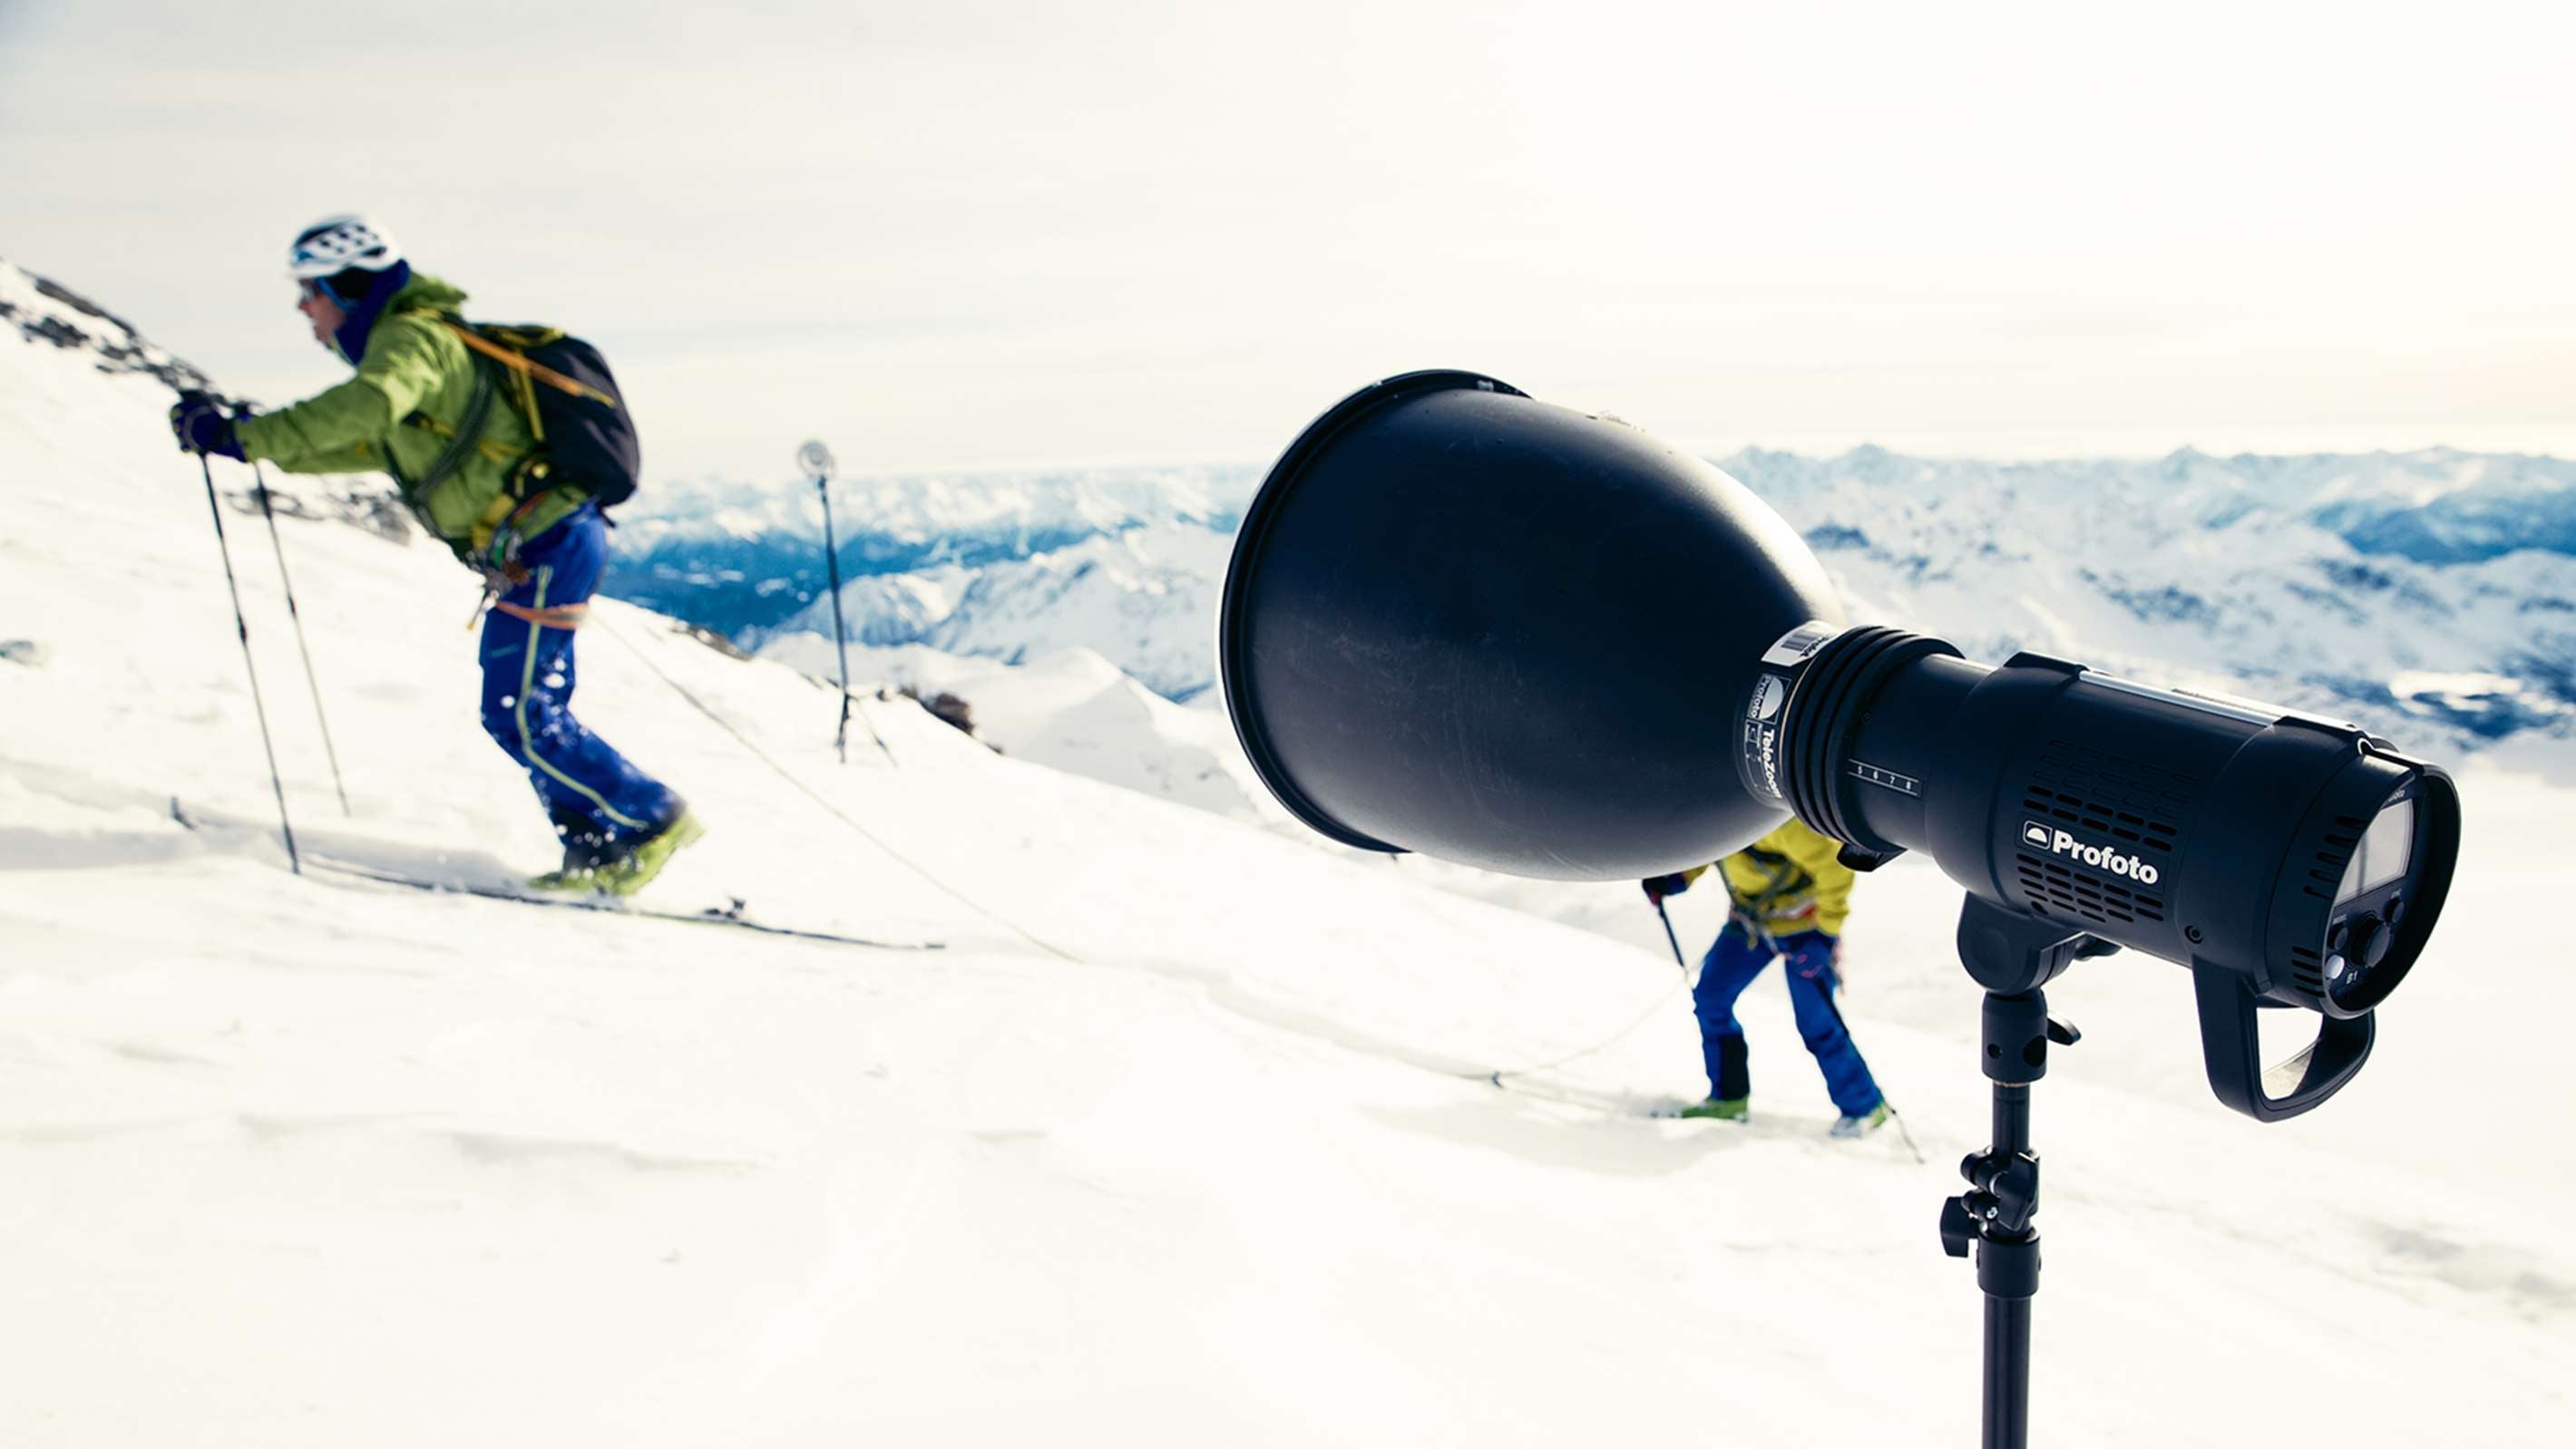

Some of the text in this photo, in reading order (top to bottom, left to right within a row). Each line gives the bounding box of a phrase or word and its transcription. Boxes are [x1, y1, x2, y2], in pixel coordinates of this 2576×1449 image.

[1857, 765, 1863, 775] 5
[1873, 771, 1879, 780] 6
[1889, 775, 1896, 784] 7
[2052, 830, 2159, 885] Profoto
